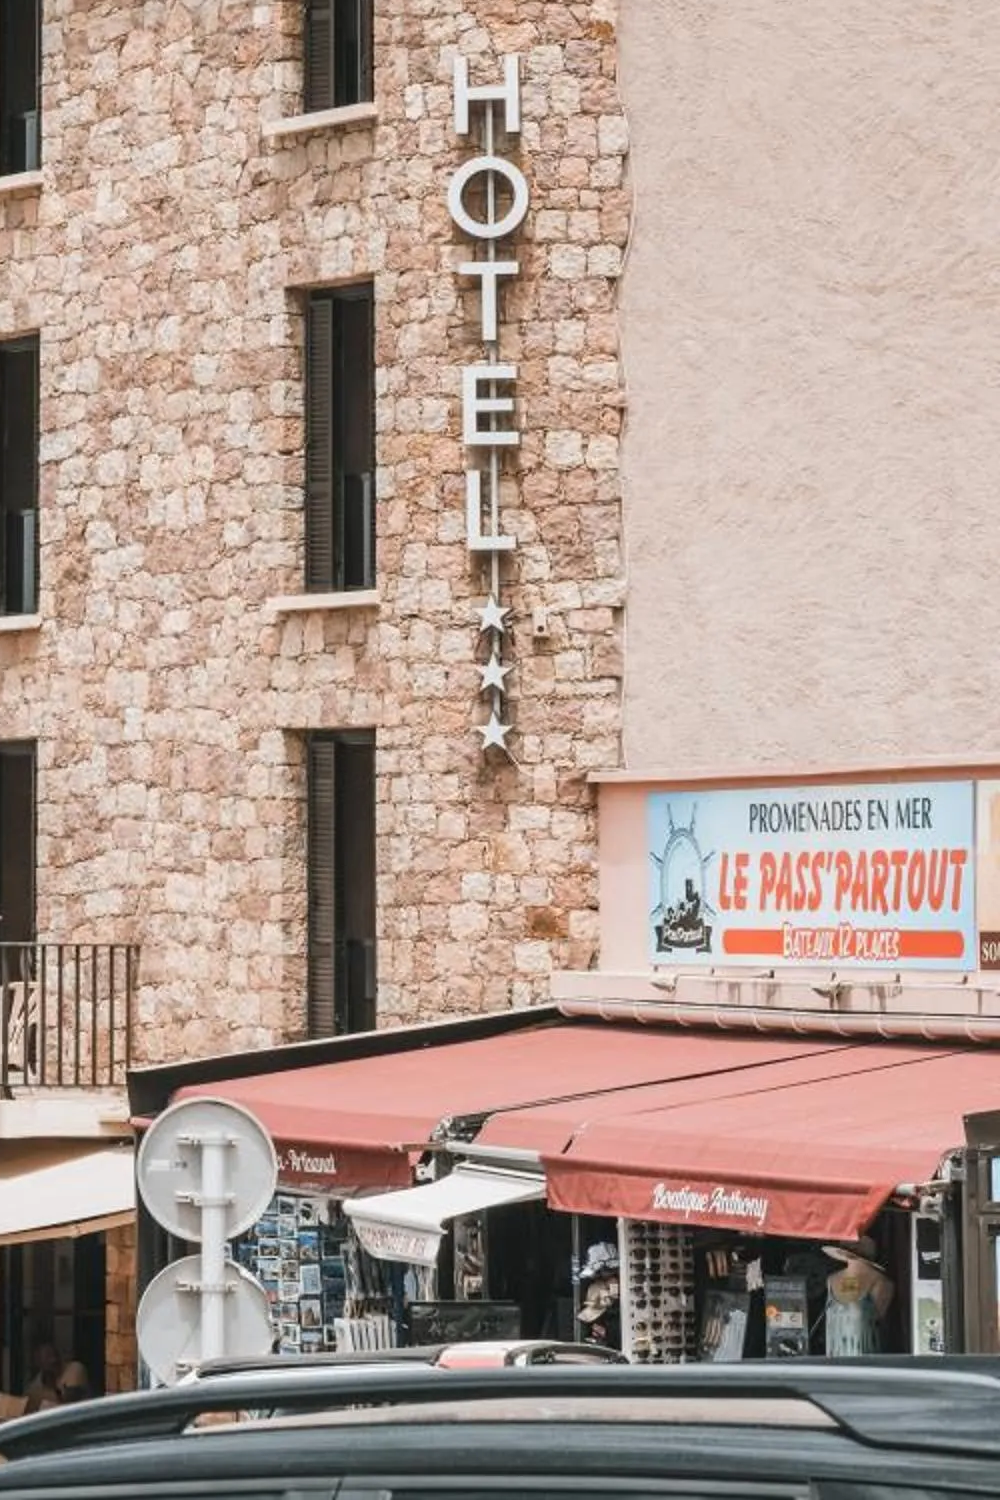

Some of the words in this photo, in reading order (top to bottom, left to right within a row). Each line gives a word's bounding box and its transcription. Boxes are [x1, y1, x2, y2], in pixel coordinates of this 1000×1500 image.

[447, 55, 529, 550] HOTEL
[748, 799, 862, 834] PROMENADES
[867, 799, 889, 830] EN
[895, 797, 933, 830] MER
[718, 851, 750, 911] LE
[759, 848, 967, 916] PASS'PARTOUT
[838, 921, 851, 958] 12
[854, 927, 901, 962] PLACES
[652, 1183, 708, 1219] Boutique
[707, 1187, 769, 1226] Anthony
